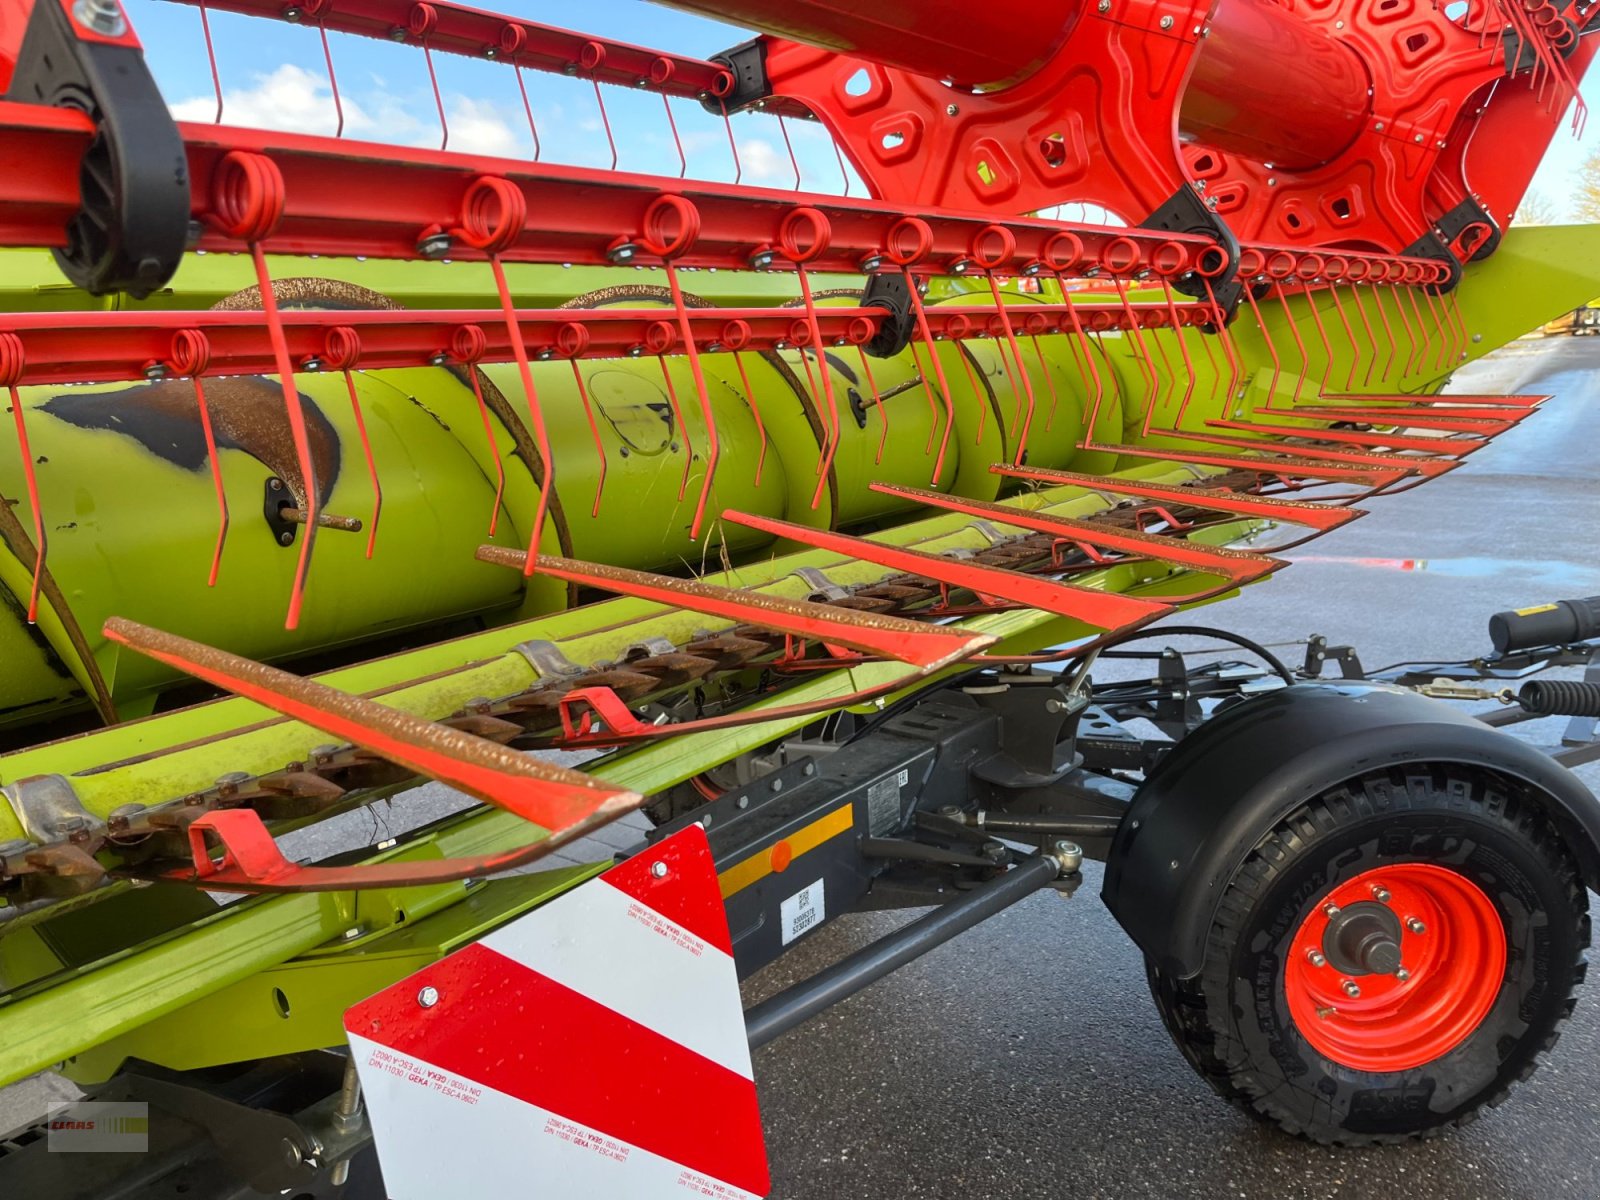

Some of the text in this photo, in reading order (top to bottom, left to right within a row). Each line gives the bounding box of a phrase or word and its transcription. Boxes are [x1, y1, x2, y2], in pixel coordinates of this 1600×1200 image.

[654, 925, 668, 936] GEKA
[666, 924, 680, 936] GEKA
[372, 1050, 392, 1062] 06021
[392, 1058, 414, 1070] ESC-A
[414, 1067, 424, 1075] TP
[368, 1058, 383, 1069] DIN
[384, 1064, 404, 1076] 11030
[408, 1074, 429, 1086] GEKA
[442, 1086, 460, 1098] ESC-A
[460, 1095, 478, 1105] 06021
[427, 1071, 447, 1084] GEKA
[450, 1080, 468, 1091] 11030
[469, 1087, 482, 1097] DIN
[544, 1126, 554, 1135] DIN
[573, 1137, 588, 1148] GEKA
[588, 1134, 603, 1144] GEKA
[620, 1147, 630, 1156] DIN
